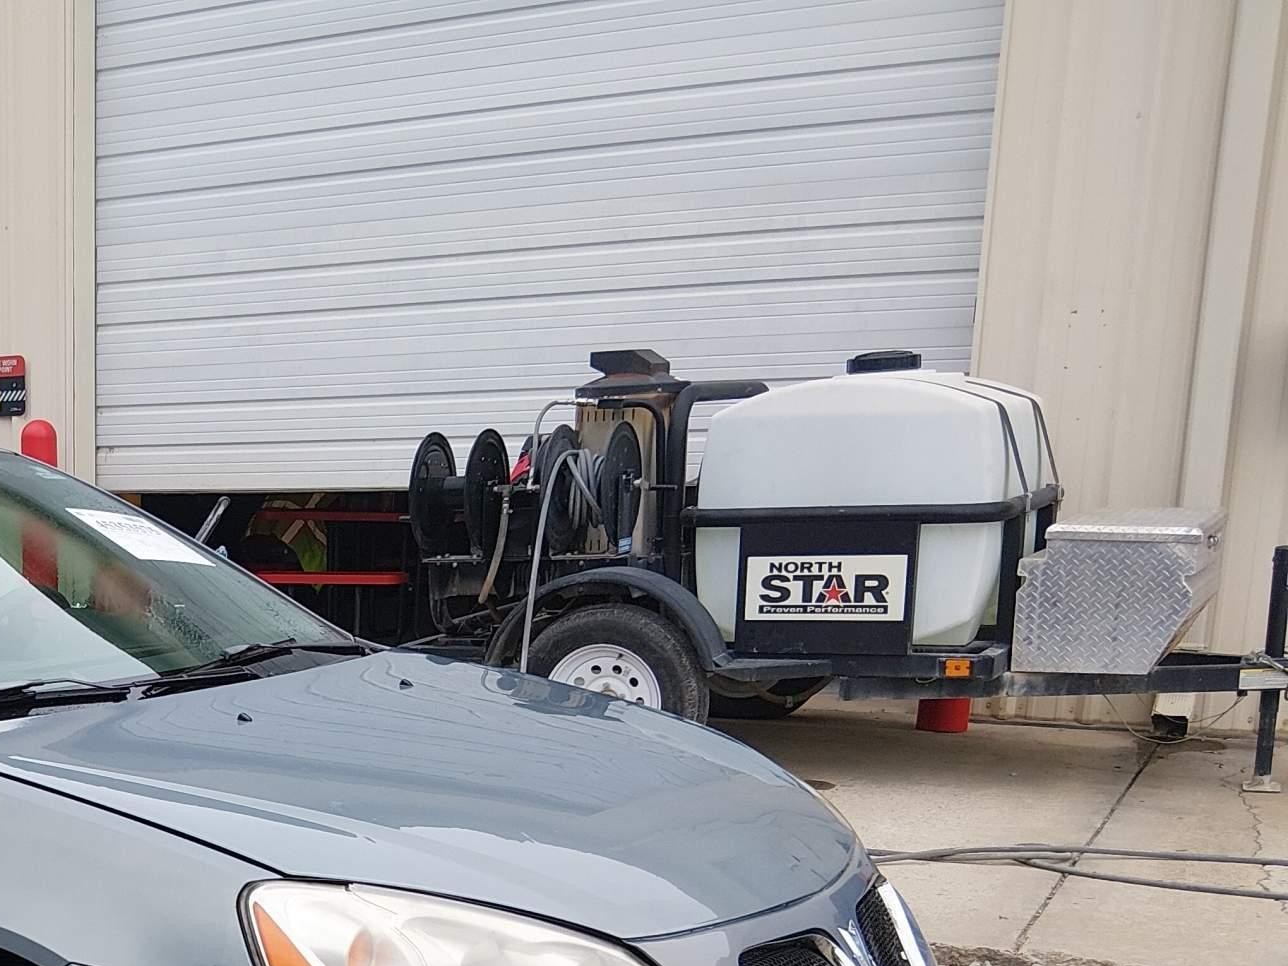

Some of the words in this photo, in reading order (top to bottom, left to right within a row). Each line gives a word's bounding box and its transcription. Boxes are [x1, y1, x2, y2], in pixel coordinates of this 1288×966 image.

[769, 561, 843, 574] NORTH
[759, 574, 890, 604] STAR
[763, 606, 804, 614] Proven
[806, 605, 885, 614] Performance
